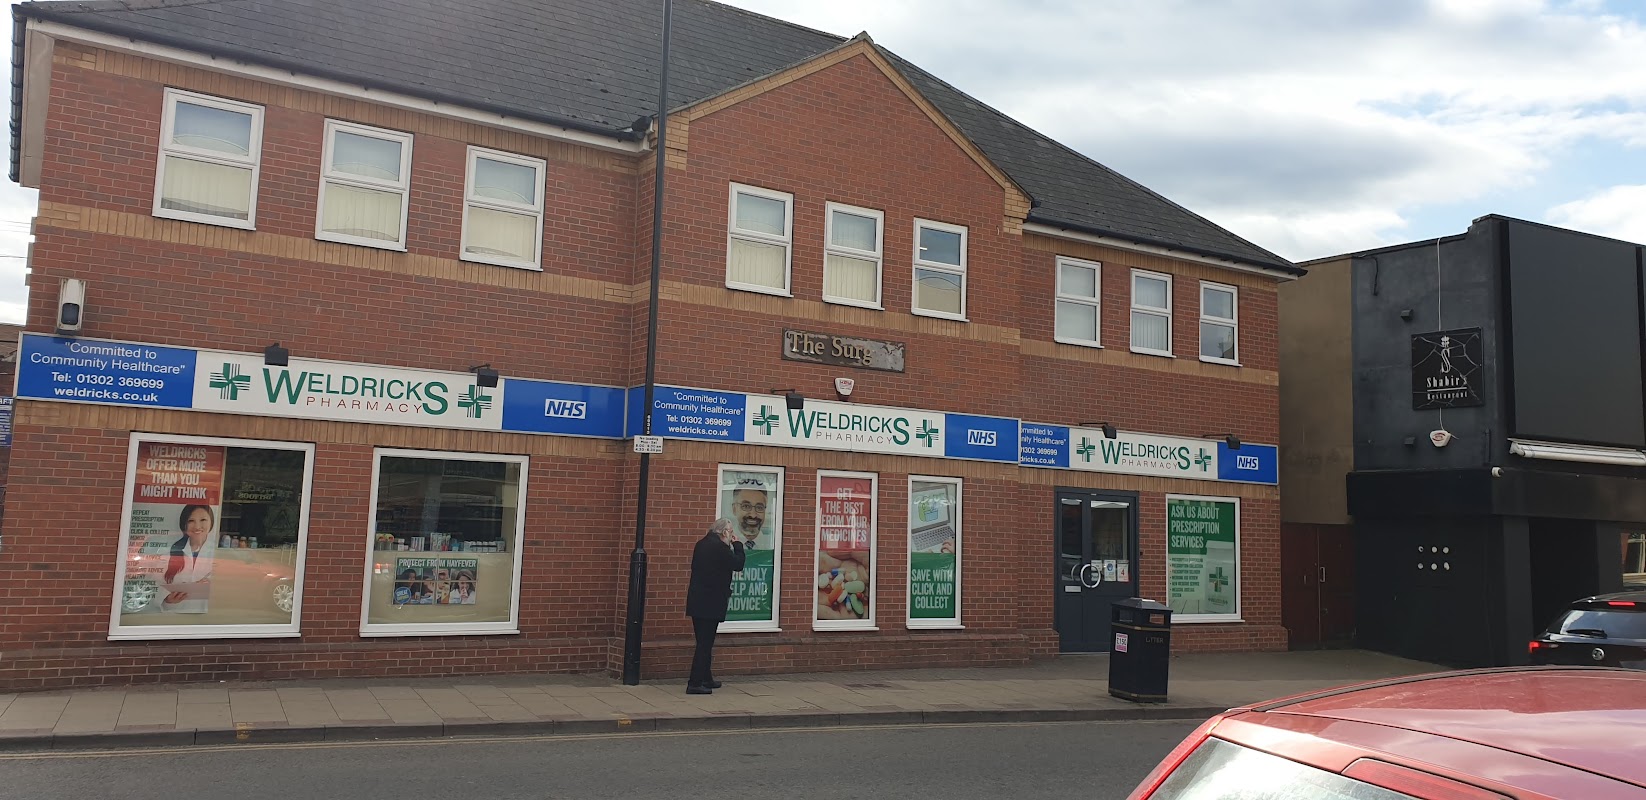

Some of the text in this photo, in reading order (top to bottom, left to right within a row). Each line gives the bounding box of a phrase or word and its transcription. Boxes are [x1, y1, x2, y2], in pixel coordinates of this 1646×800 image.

[64, 341, 158, 360] "Committed to
[787, 332, 872, 366] The Surg
[30, 351, 186, 376] Community Healthcare"
[51, 371, 164, 390] Tel: 01302 369699
[53, 386, 158, 403] weldricks.co.uk
[262, 368, 449, 416] WELDRICKS
[673, 391, 728, 405] "Committed to
[306, 396, 423, 415] PHARMACY
[546, 400, 585, 418] NHS
[654, 401, 744, 416] Community Healthcare"
[666, 415, 732, 427] Tel: 01302 369699
[787, 409, 910, 446] WELDRICKS
[668, 426, 729, 437] weldricks.co.uk
[816, 431, 894, 445] PHARMACY
[968, 430, 996, 446] NHS
[1033, 436, 1067, 446] Healthcare"
[150, 445, 207, 459] WELDRICKS
[1101, 440, 1191, 471] WELDRICKS
[146, 458, 207, 473] OFFER MORE
[1121, 458, 1178, 470] PHARMACY
[1237, 456, 1258, 469] NHS
[151, 472, 200, 486] THAN YOU
[140, 485, 207, 499] MIGHT THINK
[836, 487, 853, 500] GET
[825, 501, 864, 515] THE BEST
[1170, 505, 1219, 520] ASK US ABOUT
[821, 514, 868, 529] FROM YOUR
[1171, 521, 1220, 535] PRESCRIPTION
[821, 527, 867, 542] MEDICINES
[1171, 535, 1204, 549] SERVICES
[399, 558, 426, 568] PROTECT
[446, 559, 477, 568] HAYFEVER
[911, 568, 953, 582] SAVE WITH
[747, 582, 768, 596] AND
[911, 583, 953, 596] CLICK AND
[727, 597, 761, 611] ADVICE
[915, 596, 949, 609] COLLECT
